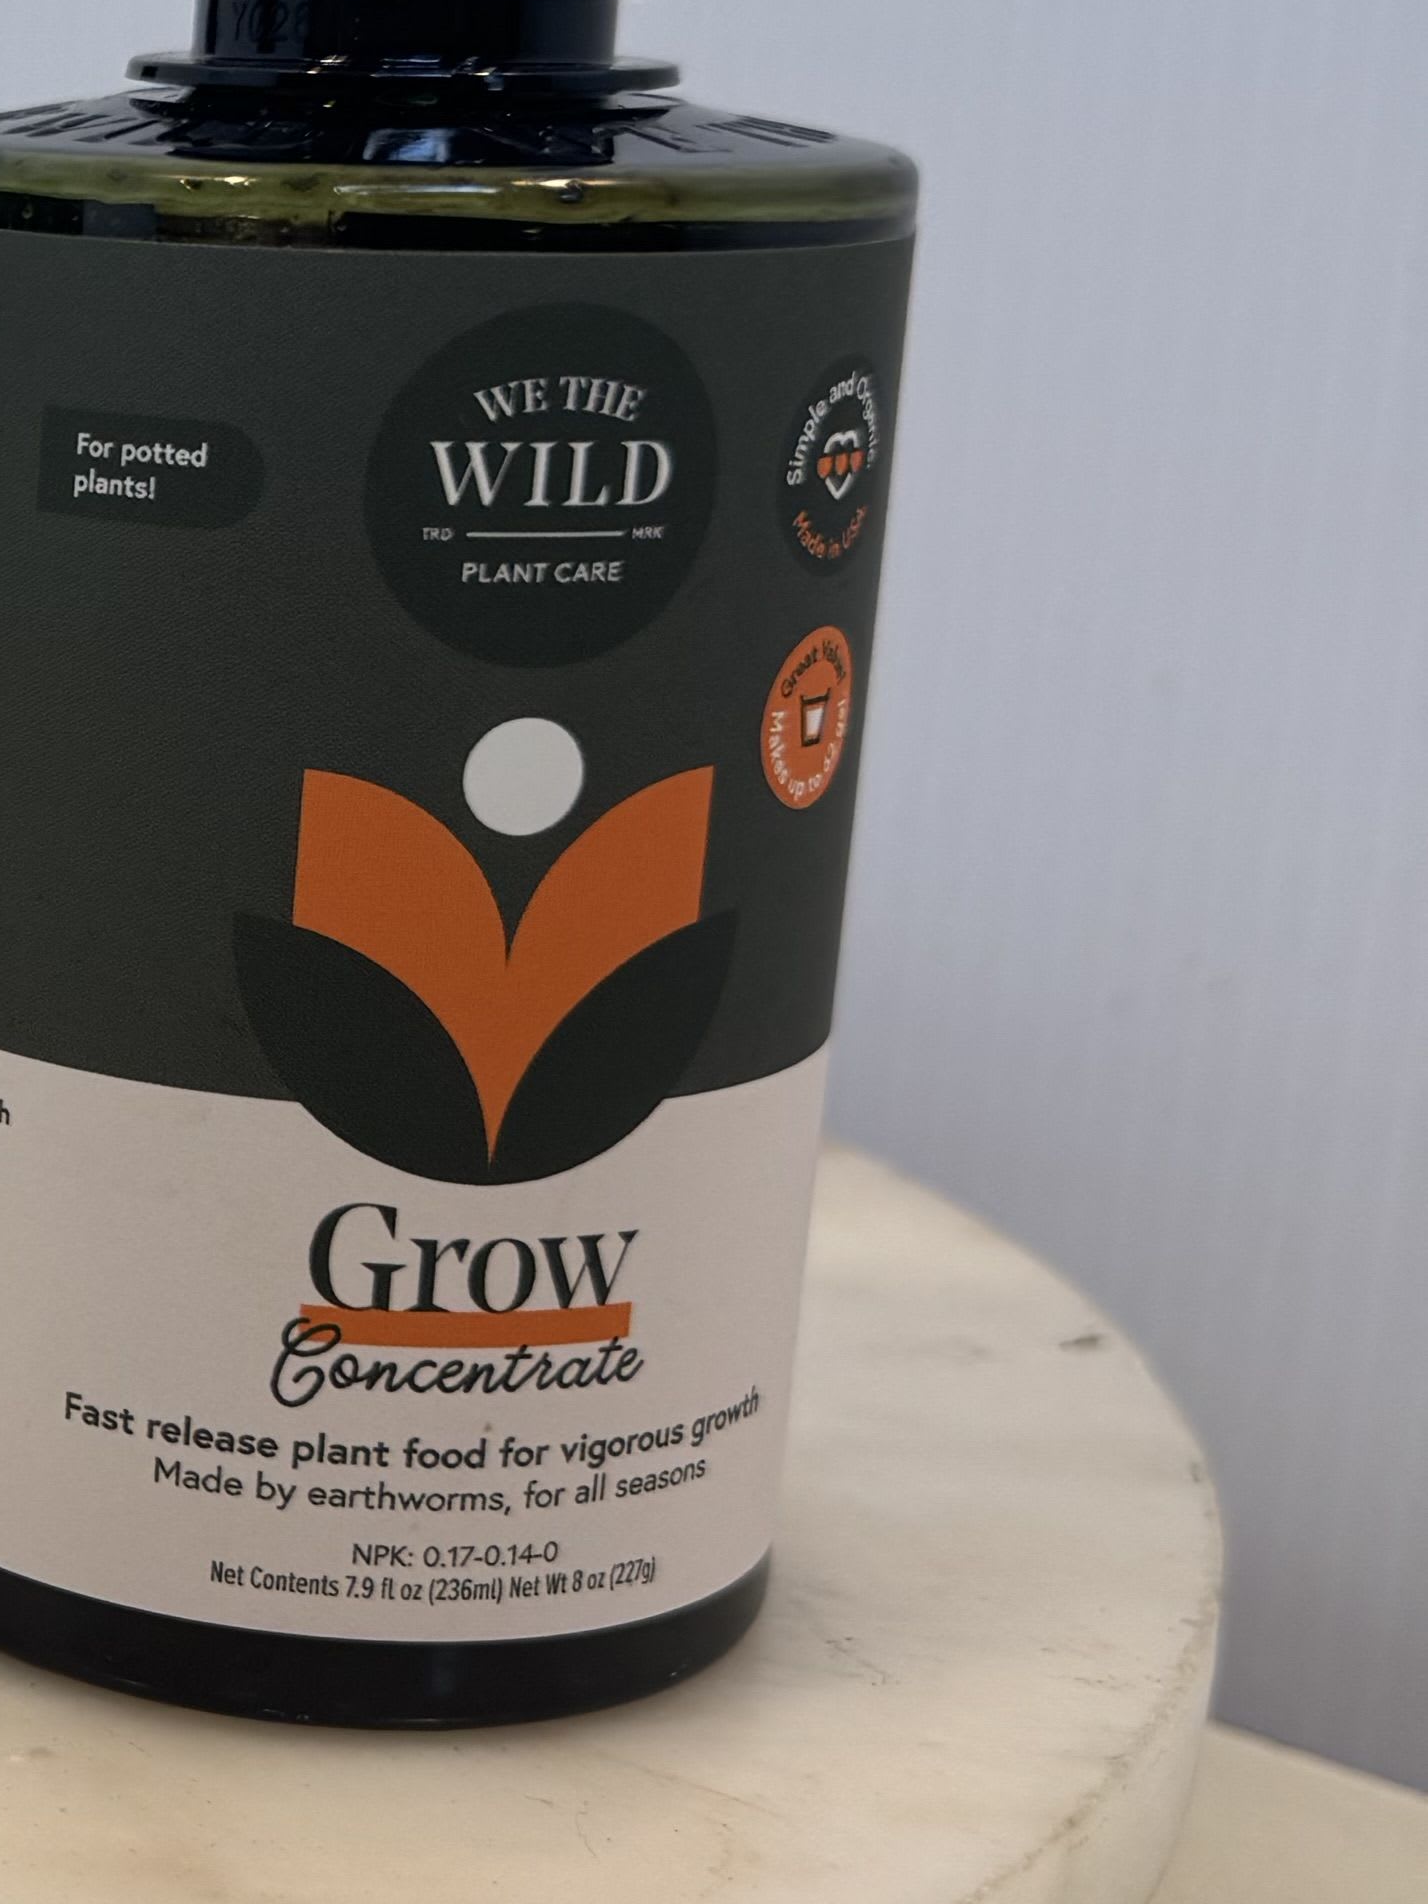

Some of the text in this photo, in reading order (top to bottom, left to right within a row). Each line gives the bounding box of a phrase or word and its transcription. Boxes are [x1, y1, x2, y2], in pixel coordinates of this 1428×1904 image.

[473, 375, 646, 423] WE THE
[77, 432, 208, 468] For potted
[786, 370, 856, 486] Simple and
[73, 467, 156, 500] plants!
[429, 440, 674, 507] WILD
[422, 526, 664, 541] TRD MRK
[461, 560, 624, 583] PLANT CARE
[780, 648, 818, 697] Great
[769, 711, 805, 801] Makes up
[309, 1203, 639, 1313] Grow
[270, 1317, 644, 1407] Concentrate
[65, 1385, 760, 1469] Fast release plant food for vigorous growth
[153, 1456, 706, 1514] Made by earthworms, for all seasons
[351, 1540, 558, 1568] NPK: 0.17-0.14-0
[210, 1556, 655, 1605] Net Contents 7.9 fl oz (236ml) Net Wt 8 oz (227g)
